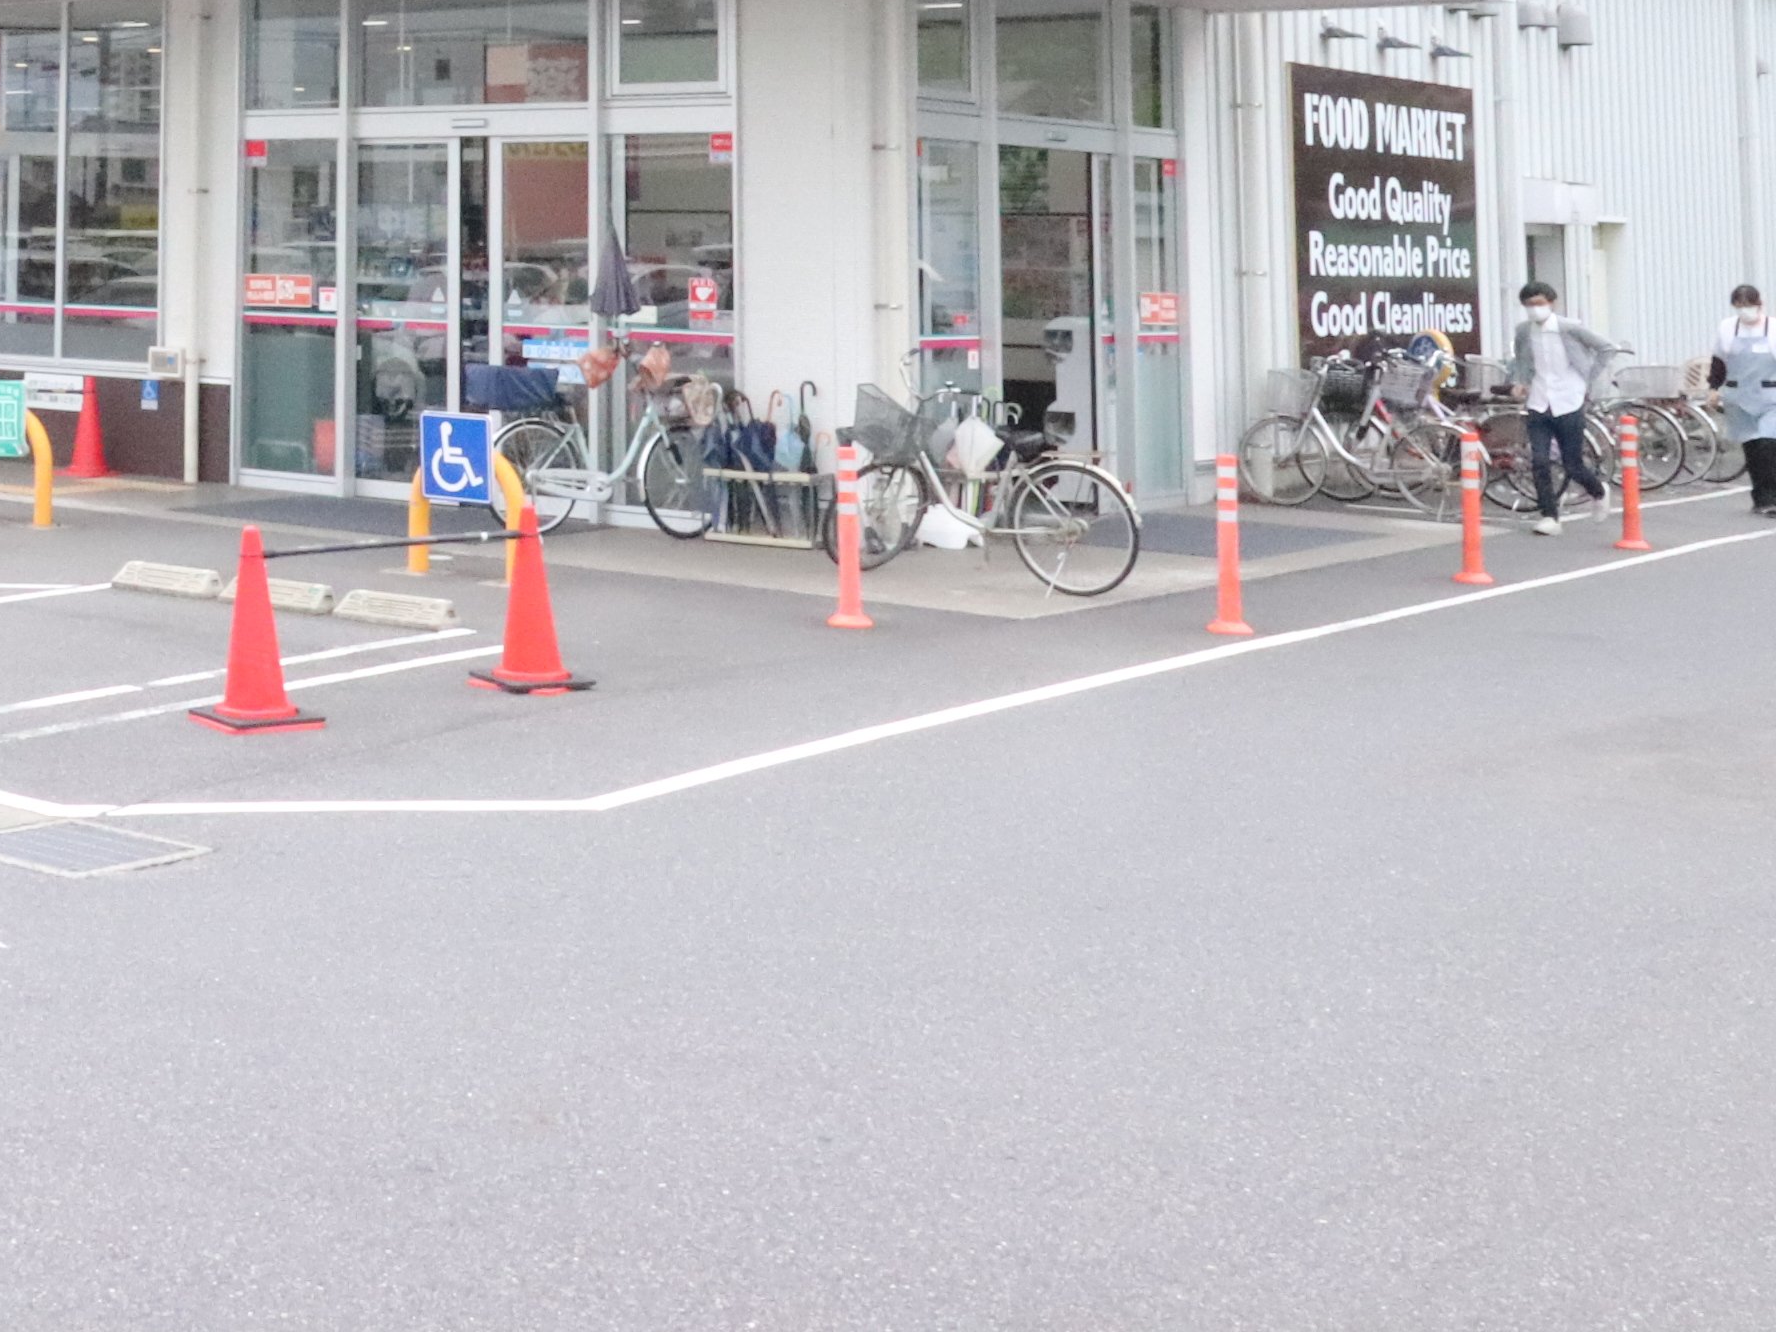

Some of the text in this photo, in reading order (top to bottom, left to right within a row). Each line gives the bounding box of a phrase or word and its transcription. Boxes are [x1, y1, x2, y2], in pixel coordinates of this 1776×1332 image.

[1304, 92, 1466, 161] FOOD MARKET
[1328, 172, 1452, 235] Good Quality
[1308, 230, 1472, 278] Reasonable Price
[1310, 290, 1473, 338] Good Cleanliness
